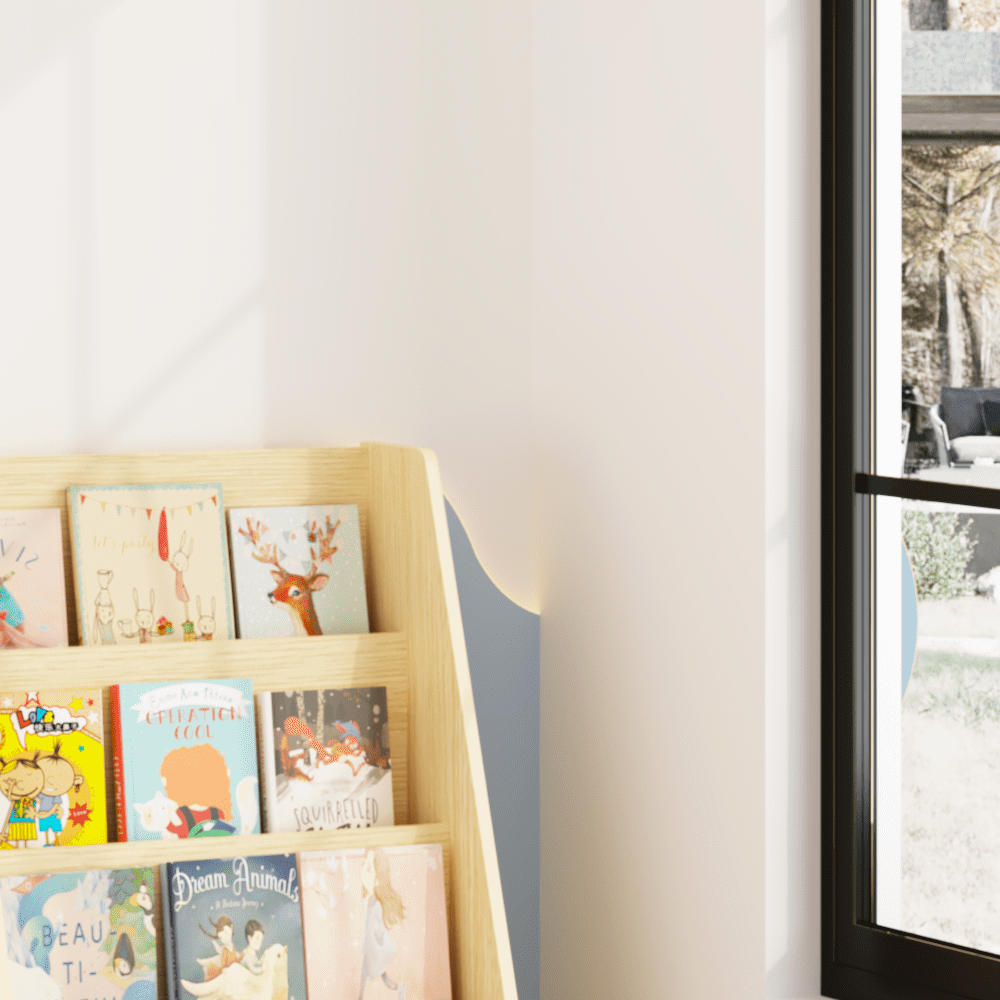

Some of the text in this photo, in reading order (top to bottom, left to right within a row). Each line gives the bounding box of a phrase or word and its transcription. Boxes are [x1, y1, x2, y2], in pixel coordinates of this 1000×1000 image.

[145, 706, 243, 726] OPERATION
[173, 723, 216, 741] COOL
[171, 856, 300, 913] Dream Animals
[42, 920, 117, 947] BEAU-
[62, 960, 97, 984] TI-
